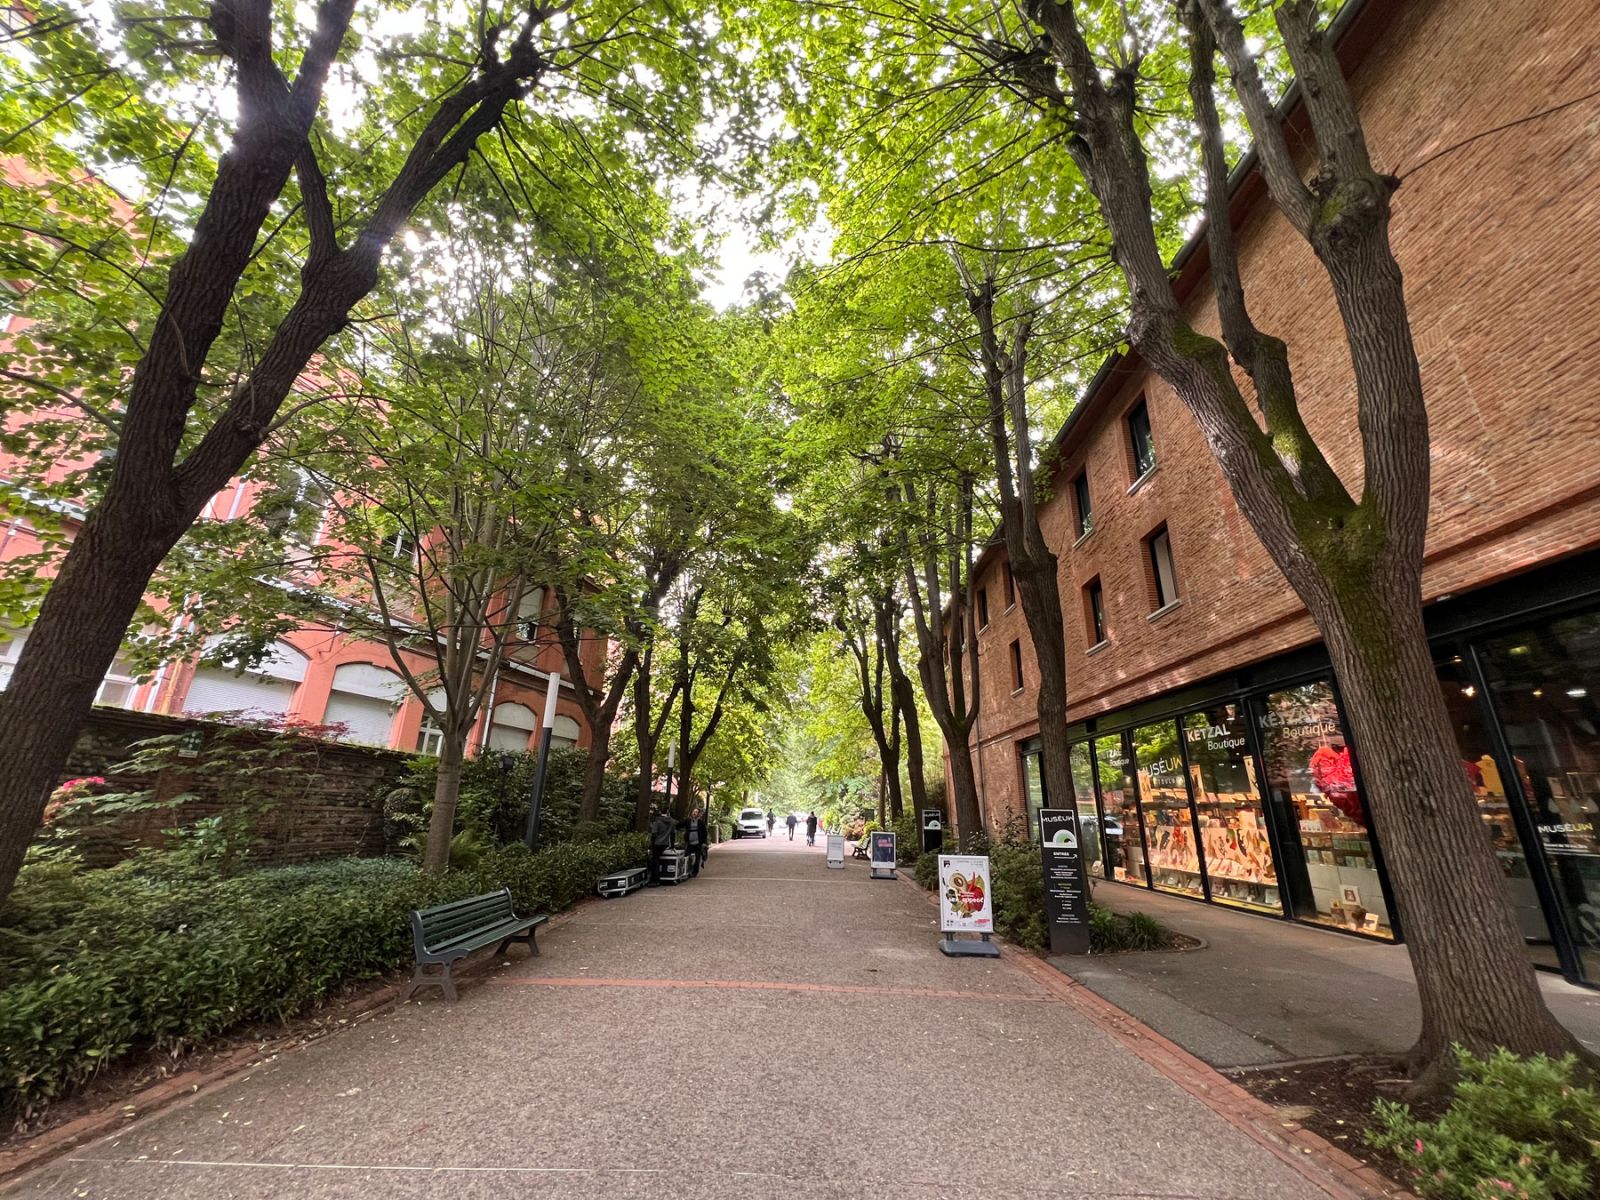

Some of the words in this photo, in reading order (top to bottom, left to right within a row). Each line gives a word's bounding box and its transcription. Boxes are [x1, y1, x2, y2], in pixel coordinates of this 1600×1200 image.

[1259, 704, 1320, 729] KETZAL
[1187, 724, 1231, 742] KETZAL
[1282, 721, 1336, 739] Boutique
[1207, 737, 1245, 751] Boutique
